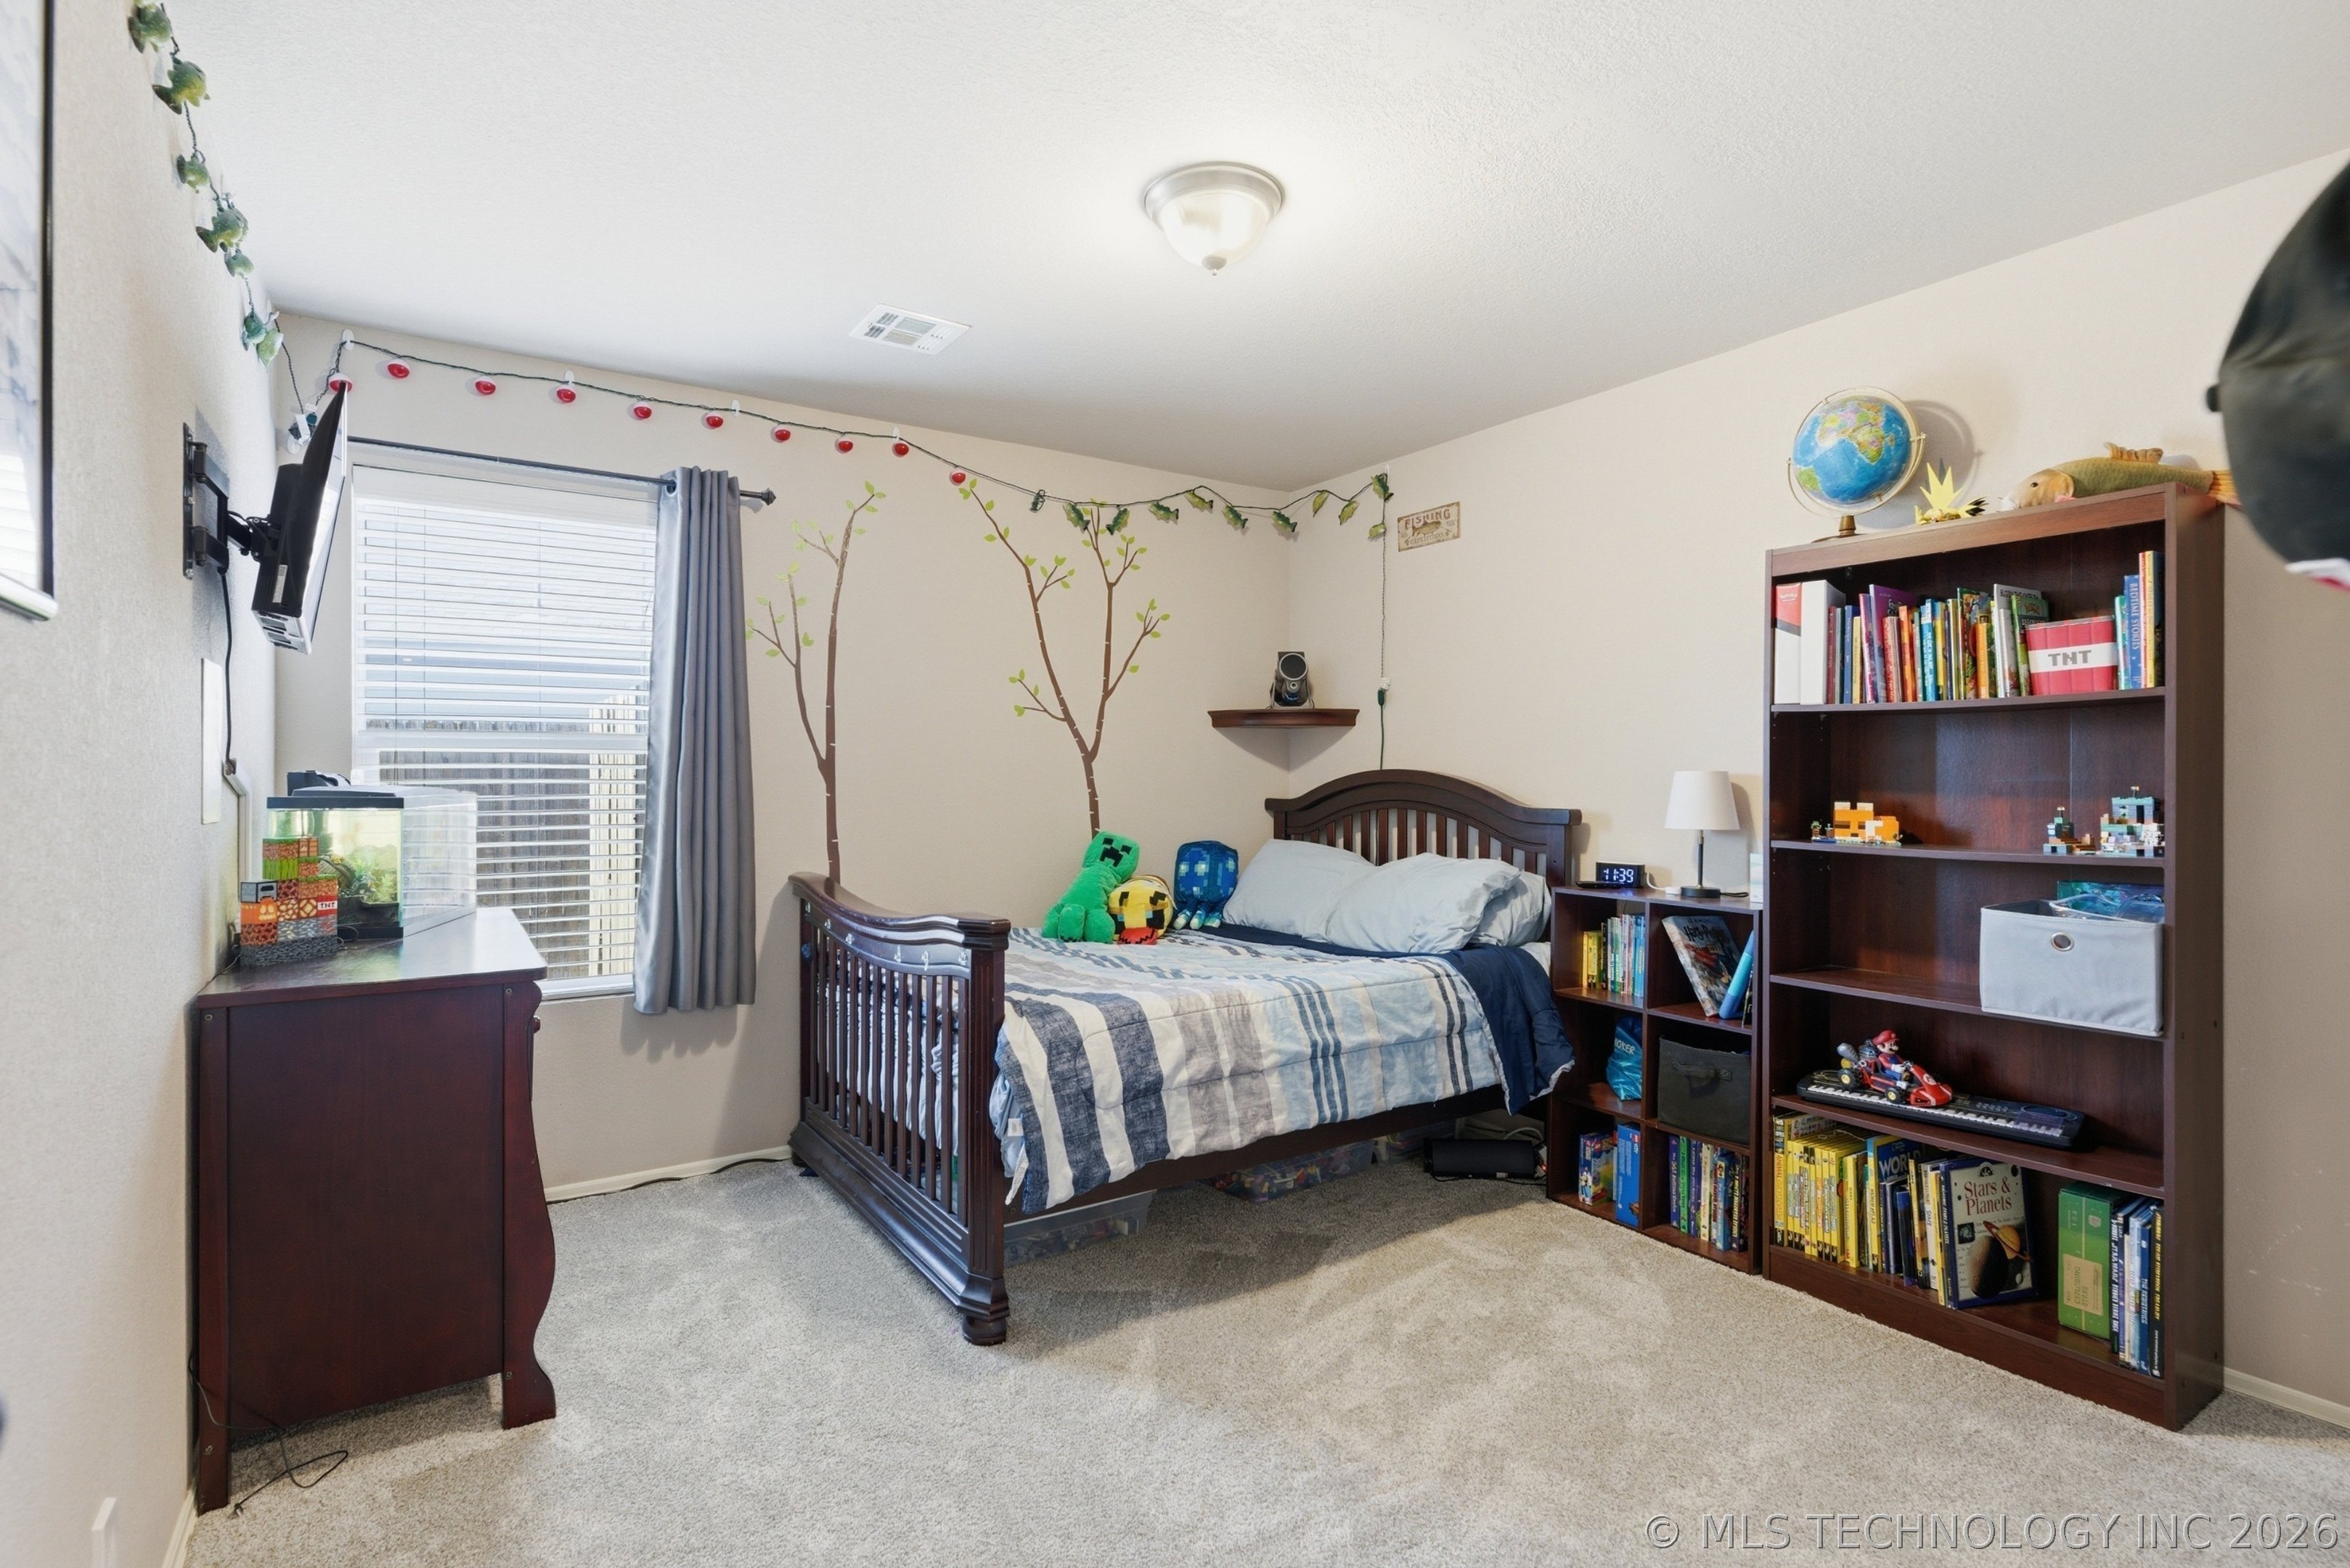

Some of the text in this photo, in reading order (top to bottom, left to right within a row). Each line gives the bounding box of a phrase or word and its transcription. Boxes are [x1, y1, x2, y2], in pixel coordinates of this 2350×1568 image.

[1405, 509, 1451, 530] FISHING
[2129, 583, 2140, 650] BEDTIME STORIES
[2048, 650, 2092, 666] TNT
[1603, 868, 1633, 883] 11:39
[1965, 1180, 1997, 1199] Stars
[2002, 1176, 2011, 1193] &
[1966, 1196, 2012, 1216] Planets
